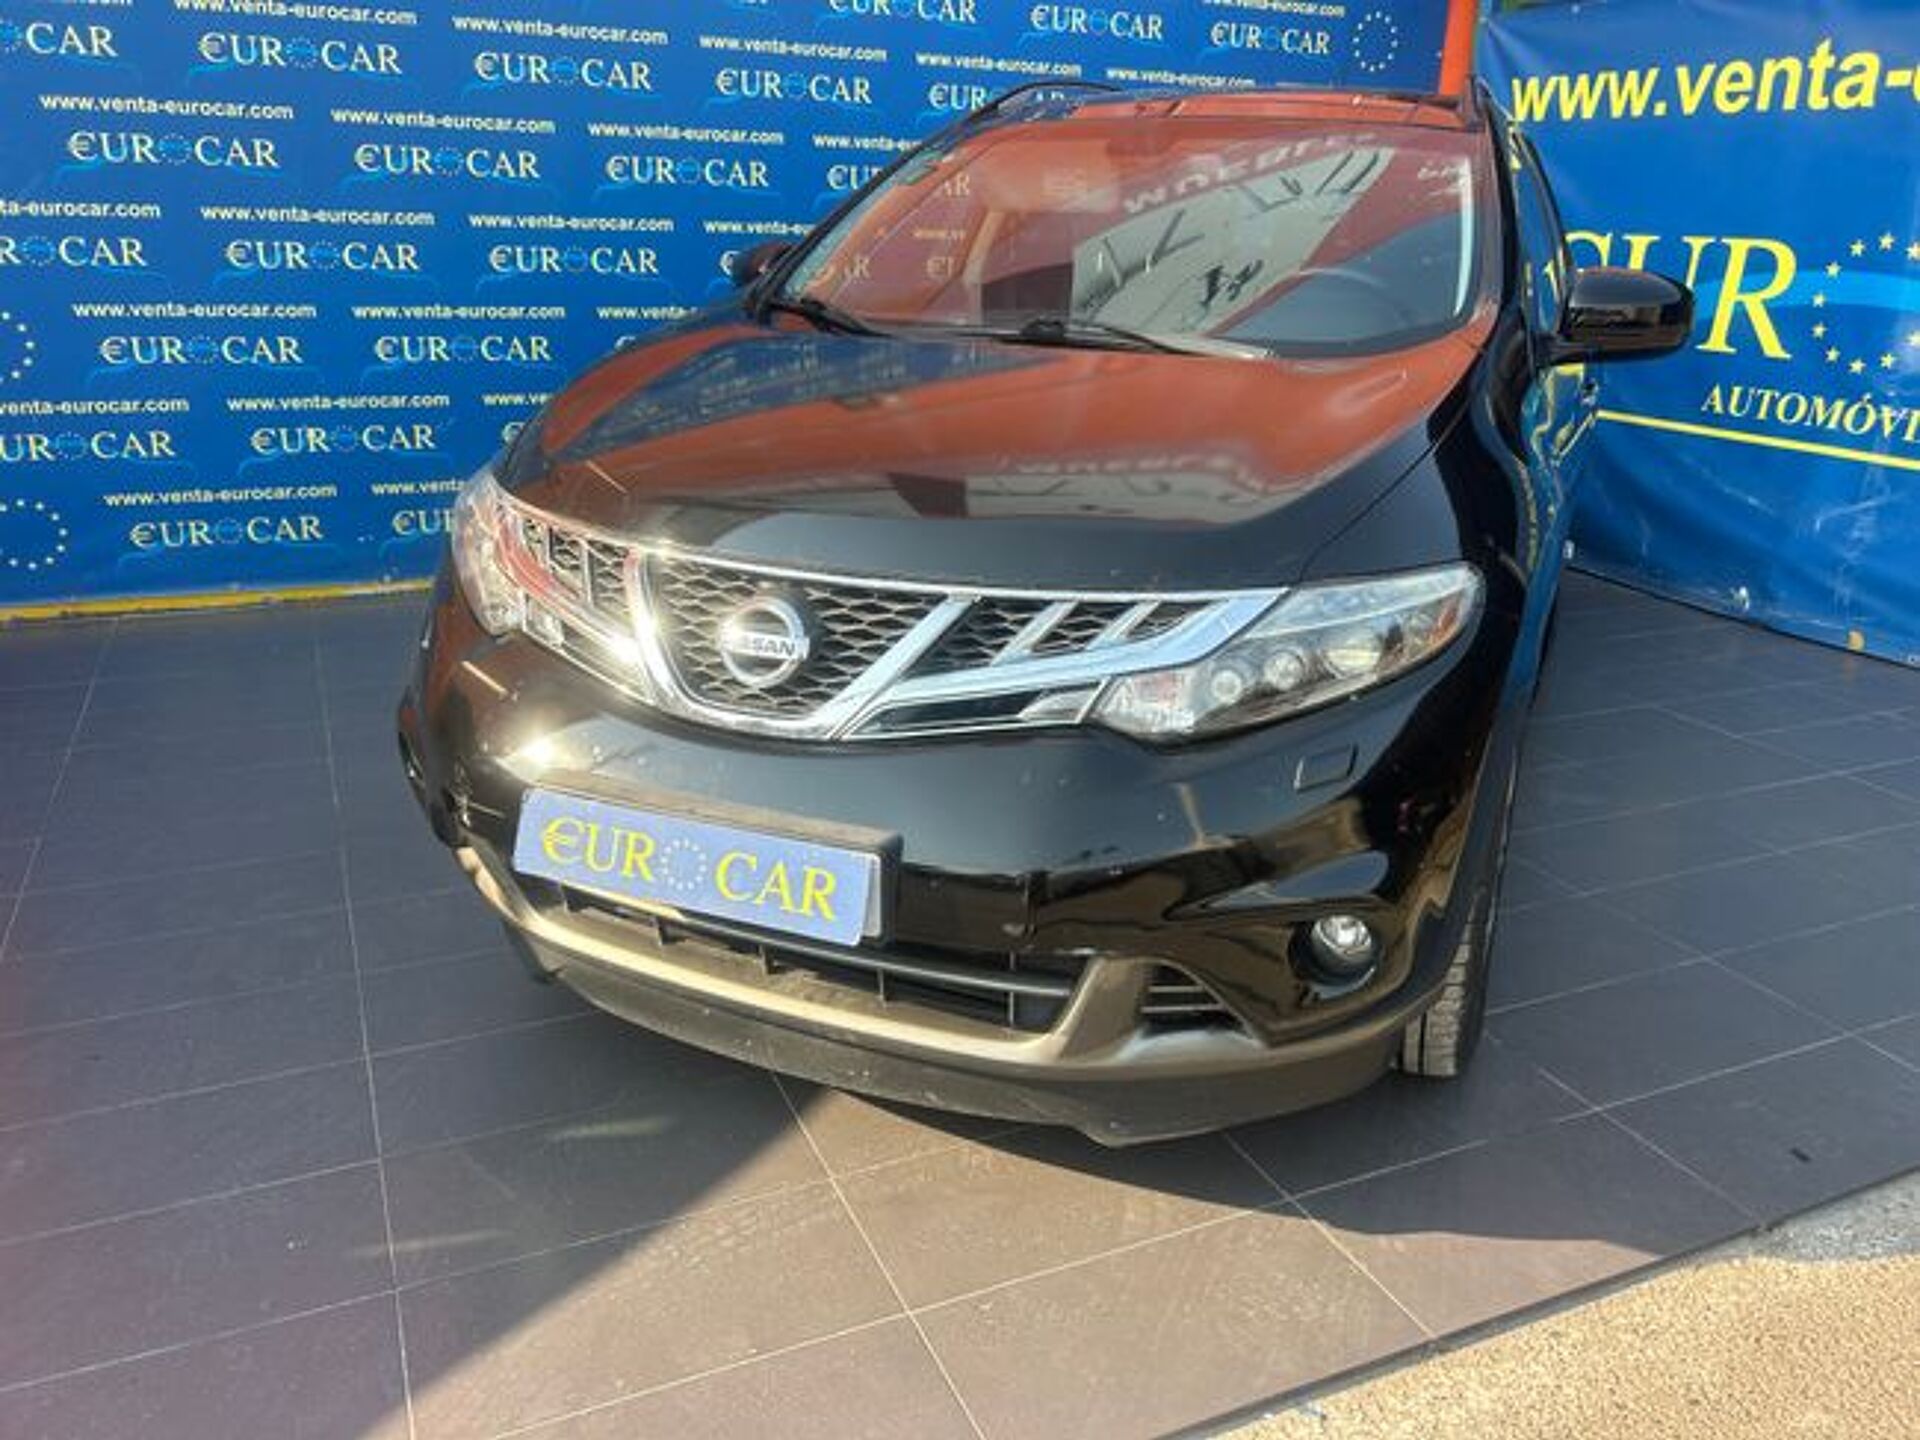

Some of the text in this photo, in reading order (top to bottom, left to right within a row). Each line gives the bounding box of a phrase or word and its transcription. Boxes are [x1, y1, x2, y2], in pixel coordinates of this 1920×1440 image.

[451, 16, 668, 45] www.venta-eurocar.com
[699, 35, 887, 62] www.venta-eurocar.com
[915, 52, 1082, 78] www.venta-eurocar.com
[1513, 38, 1920, 122] www.venta-
[39, 94, 294, 120] www.venta-eurocar.com
[330, 108, 556, 134] www.venta-eurocar.com
[587, 122, 784, 145] www.venta-eurocar.com
[200, 206, 435, 226] www.venta-eurocar.com
[468, 214, 674, 232] www.venta-eurocar.com
[72, 301, 317, 319] www.venta-eurocar.com
[351, 303, 566, 320] www.venta-eurocar.com
[226, 394, 450, 411] www.venta-eurocar.com
[1702, 384, 1920, 441] AUTOMÓVI
[102, 484, 338, 507] www.venta-eurocar.com
